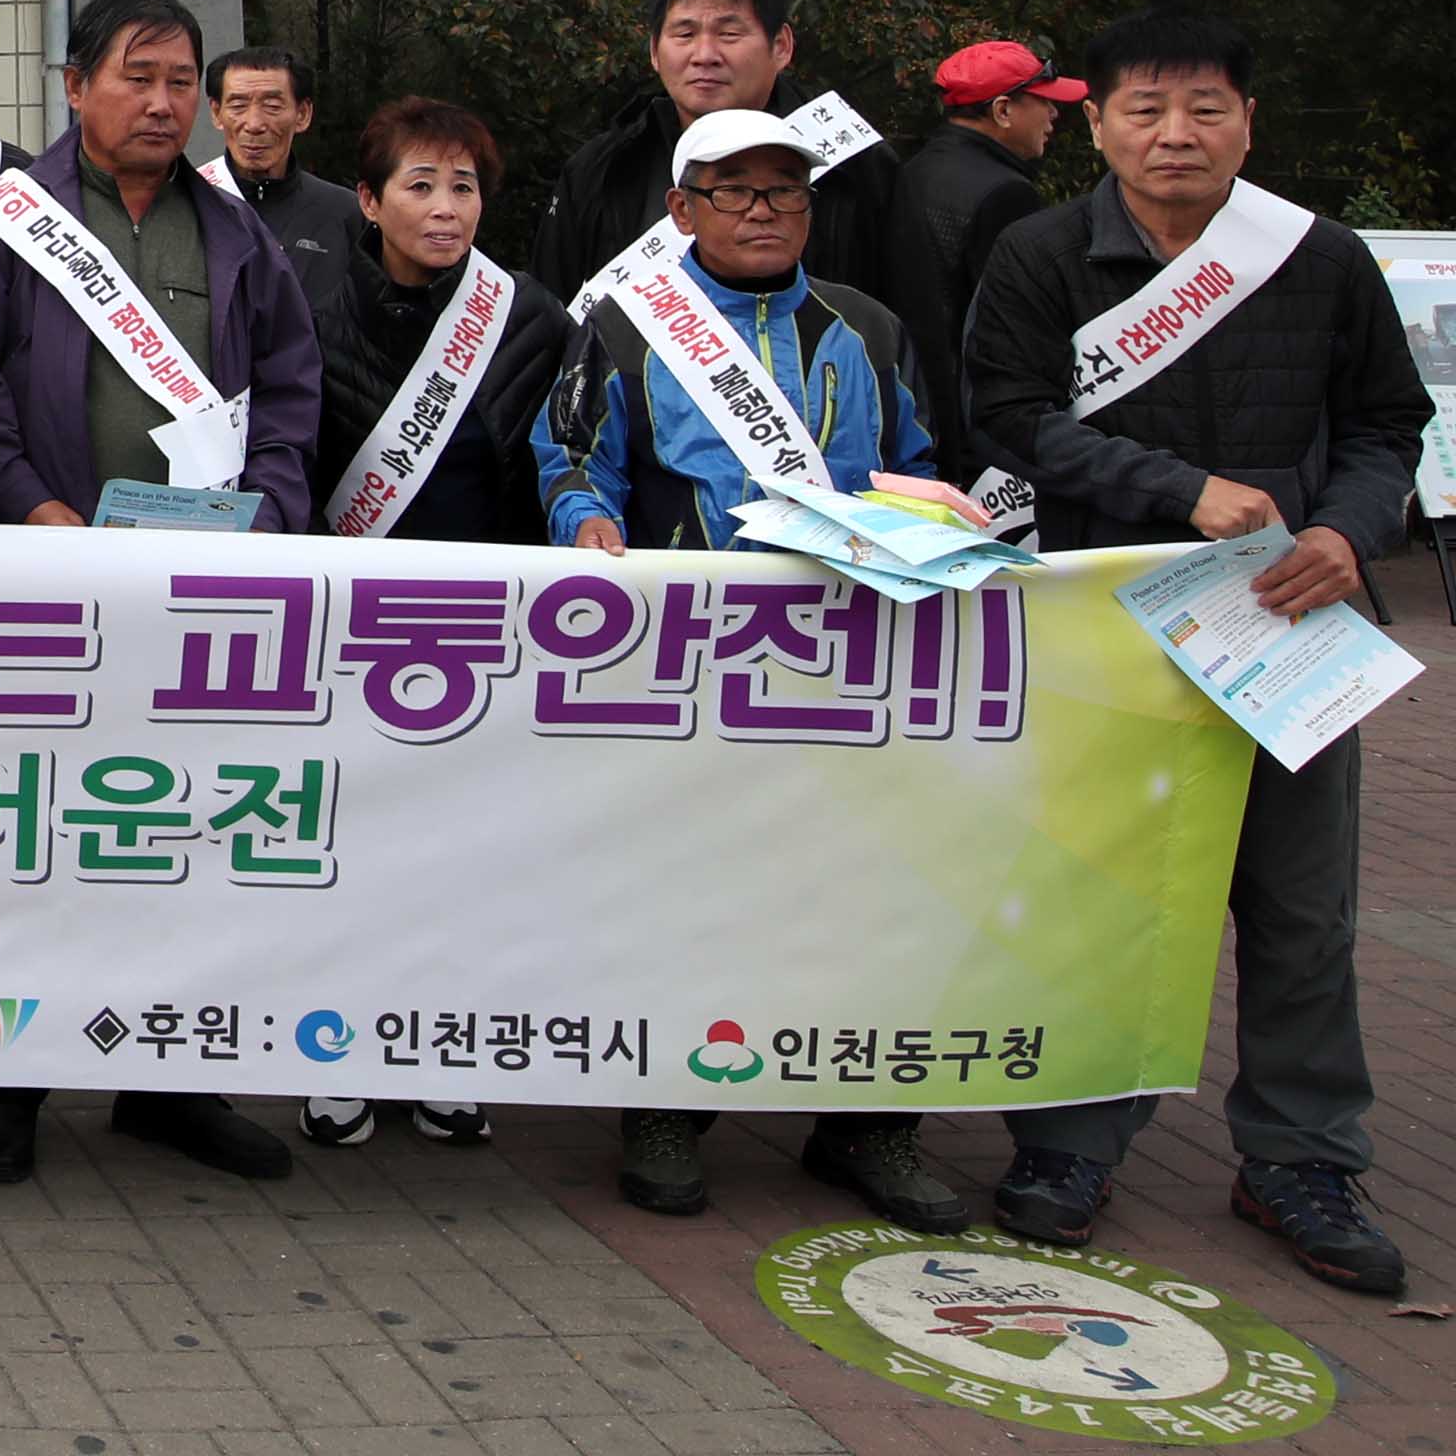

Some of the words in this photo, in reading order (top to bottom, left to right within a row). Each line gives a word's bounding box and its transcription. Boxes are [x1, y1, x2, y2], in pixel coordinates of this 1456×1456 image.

[1115, 260, 1236, 367] 음주운전
[152, 572, 1020, 736] 교통안전!!
[135, 1002, 242, 1063] 후원
[374, 1009, 652, 1079] 인천광역시
[770, 1023, 1047, 1085] 인천동구청
